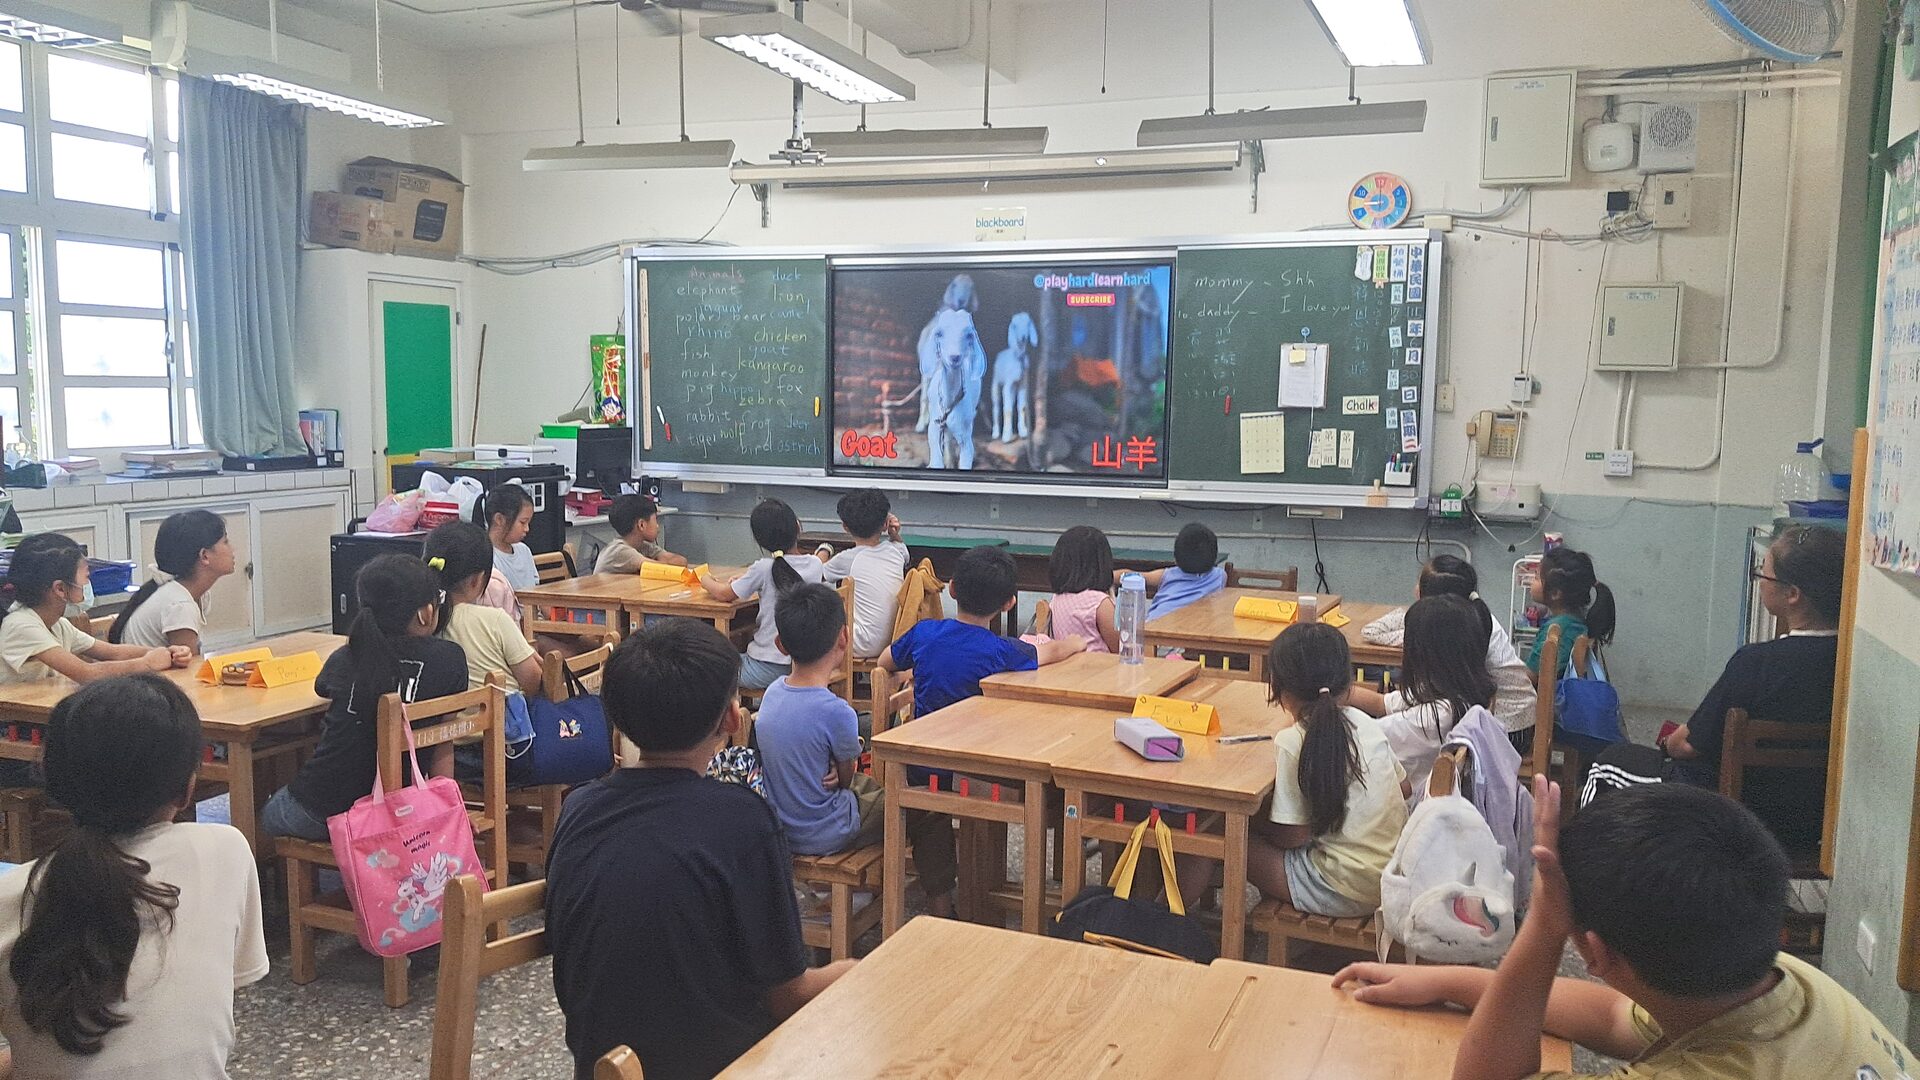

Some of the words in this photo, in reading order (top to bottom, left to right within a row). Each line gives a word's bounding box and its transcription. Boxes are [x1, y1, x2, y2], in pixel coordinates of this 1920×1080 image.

[975, 216, 1024, 228] blackboard
[772, 266, 802, 282] duck
[1034, 271, 1152, 291] @playhardlearnhard
[1280, 269, 1315, 288] Shh
[1409, 246, 1423, 300] 中華民國
[676, 282, 743, 302] elephant
[1070, 295, 1112, 304] SUBSCRIBE
[1195, 276, 1254, 305] mommy
[769, 299, 811, 319] camel
[1280, 294, 1291, 314] I
[1302, 296, 1327, 312] love
[676, 307, 717, 335] polar
[732, 310, 766, 322] bear
[1197, 301, 1240, 328] daddy
[687, 321, 733, 340] rhino
[754, 326, 808, 343] chicken
[1408, 322, 1423, 336] 年
[680, 338, 712, 360] fish
[749, 344, 790, 360] goat
[1408, 349, 1420, 363] 月
[681, 363, 738, 382] monkey
[738, 347, 805, 385] kangaroo
[685, 382, 714, 406] pig
[720, 381, 754, 401] hippo
[776, 374, 804, 395] fox
[1403, 388, 1416, 401] 日
[738, 390, 786, 407] zebra
[1346, 399, 1375, 411] Chalk
[686, 406, 731, 423] rabbit
[688, 432, 717, 459] tiger
[739, 431, 772, 455] bird
[840, 429, 898, 460] Goat
[1091, 434, 1158, 471] 山羊
[410, 840, 431, 854] magic
